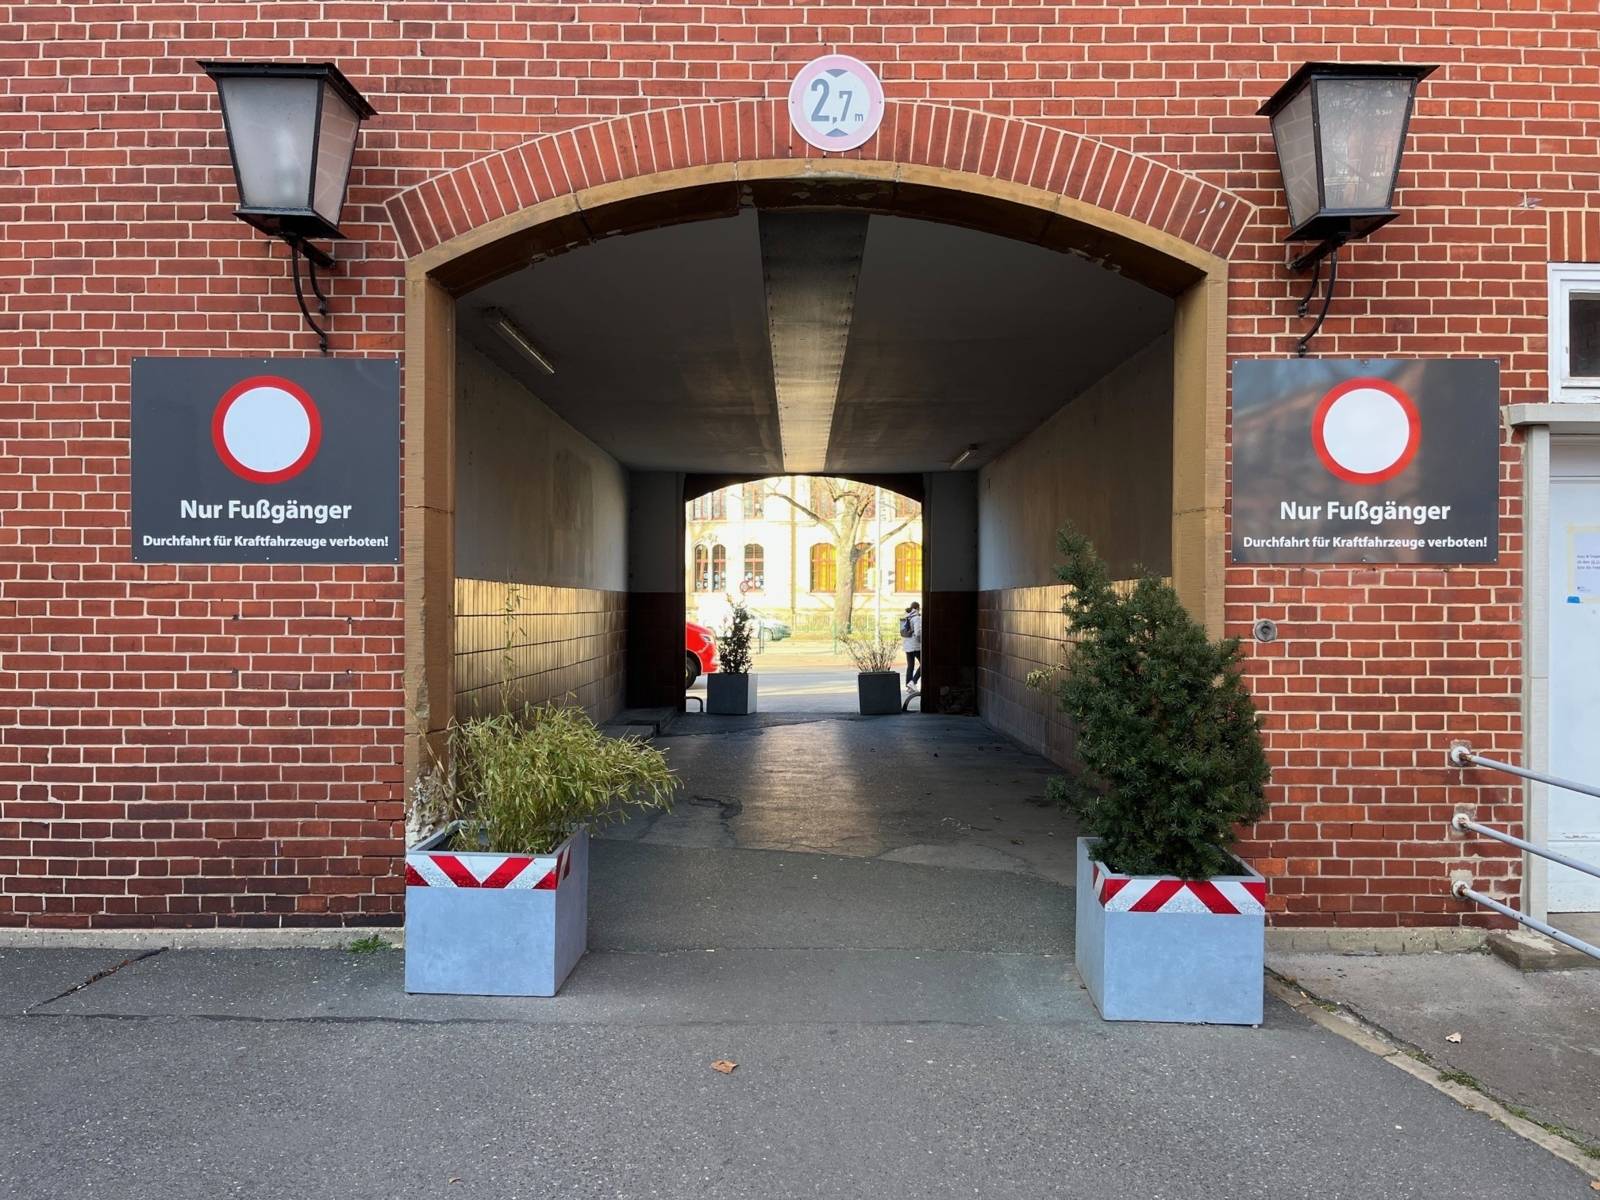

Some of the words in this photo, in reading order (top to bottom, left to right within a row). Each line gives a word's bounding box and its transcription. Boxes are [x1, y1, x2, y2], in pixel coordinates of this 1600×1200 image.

[810, 78, 853, 124] 2,7
[854, 113, 864, 122] m
[180, 500, 223, 519] Nur
[228, 499, 353, 524] Fußgänger
[1280, 501, 1322, 520] Nur
[1327, 500, 1451, 525] Fußgänger
[143, 535, 212, 547] Durchfahrt
[213, 535, 232, 547] für
[234, 535, 327, 549] Kraftfahrzeuge
[329, 535, 389, 547] verboten!
[1243, 536, 1310, 548] Durchfahrt
[1312, 536, 1331, 548] für
[1332, 536, 1426, 550] Kraftfahrzeuge
[1428, 536, 1488, 548] verboten!
